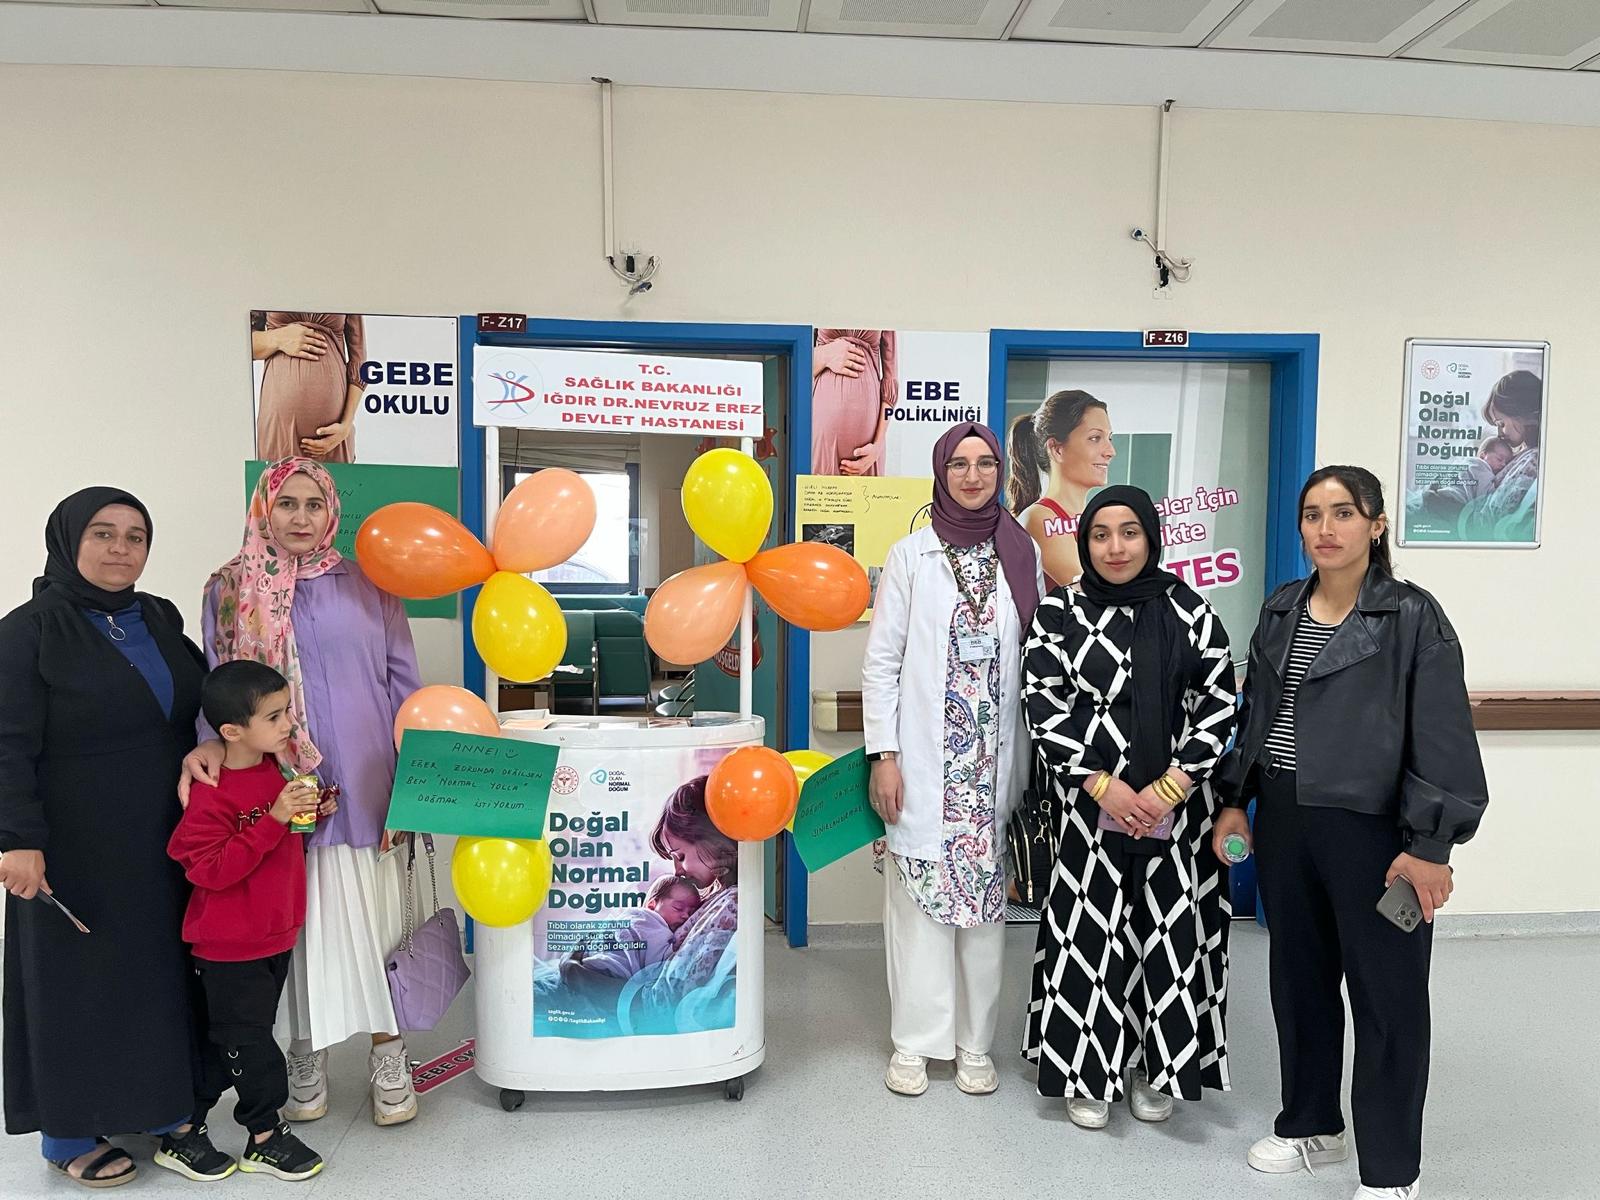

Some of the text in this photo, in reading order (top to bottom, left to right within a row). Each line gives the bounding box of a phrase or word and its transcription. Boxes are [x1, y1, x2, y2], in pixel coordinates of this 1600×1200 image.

[498, 316, 523, 329] Z17
[1164, 333, 1184, 343] Z16
[360, 361, 454, 386] GEBE
[638, 364, 671, 375] T.C.
[565, 377, 742, 397] SAĞLIK BAKANLIĞI
[906, 381, 960, 401] EBE
[364, 394, 450, 416] OKULU
[544, 392, 762, 415] IĞDIR DR.NEVRUZ EREZ
[1419, 391, 1470, 408] Doğal
[562, 412, 744, 431] DEVLET HASTANESİ
[884, 405, 981, 422] POLİKLİNİĞİ
[1419, 408, 1460, 422] Olan
[1418, 426, 1482, 440] Normal
[1417, 442, 1479, 460] Doğum
[1043, 487, 1239, 537] Mut eler İçin
[1160, 522, 1208, 548] ikte
[1167, 553, 1240, 587] TES
[411, 760, 438, 769] EĞER
[454, 765, 495, 774] ZORUNDA
[406, 776, 427, 785] BEN
[417, 794, 458, 804] DOĞMAK
[550, 811, 629, 837] Doğal
[549, 837, 613, 858] Olan
[551, 861, 649, 884] Normal
[548, 888, 646, 913] Doğum
[548, 921, 630, 930] Tıbbi olarak zorunlu
[587, 942, 611, 953] doğal
